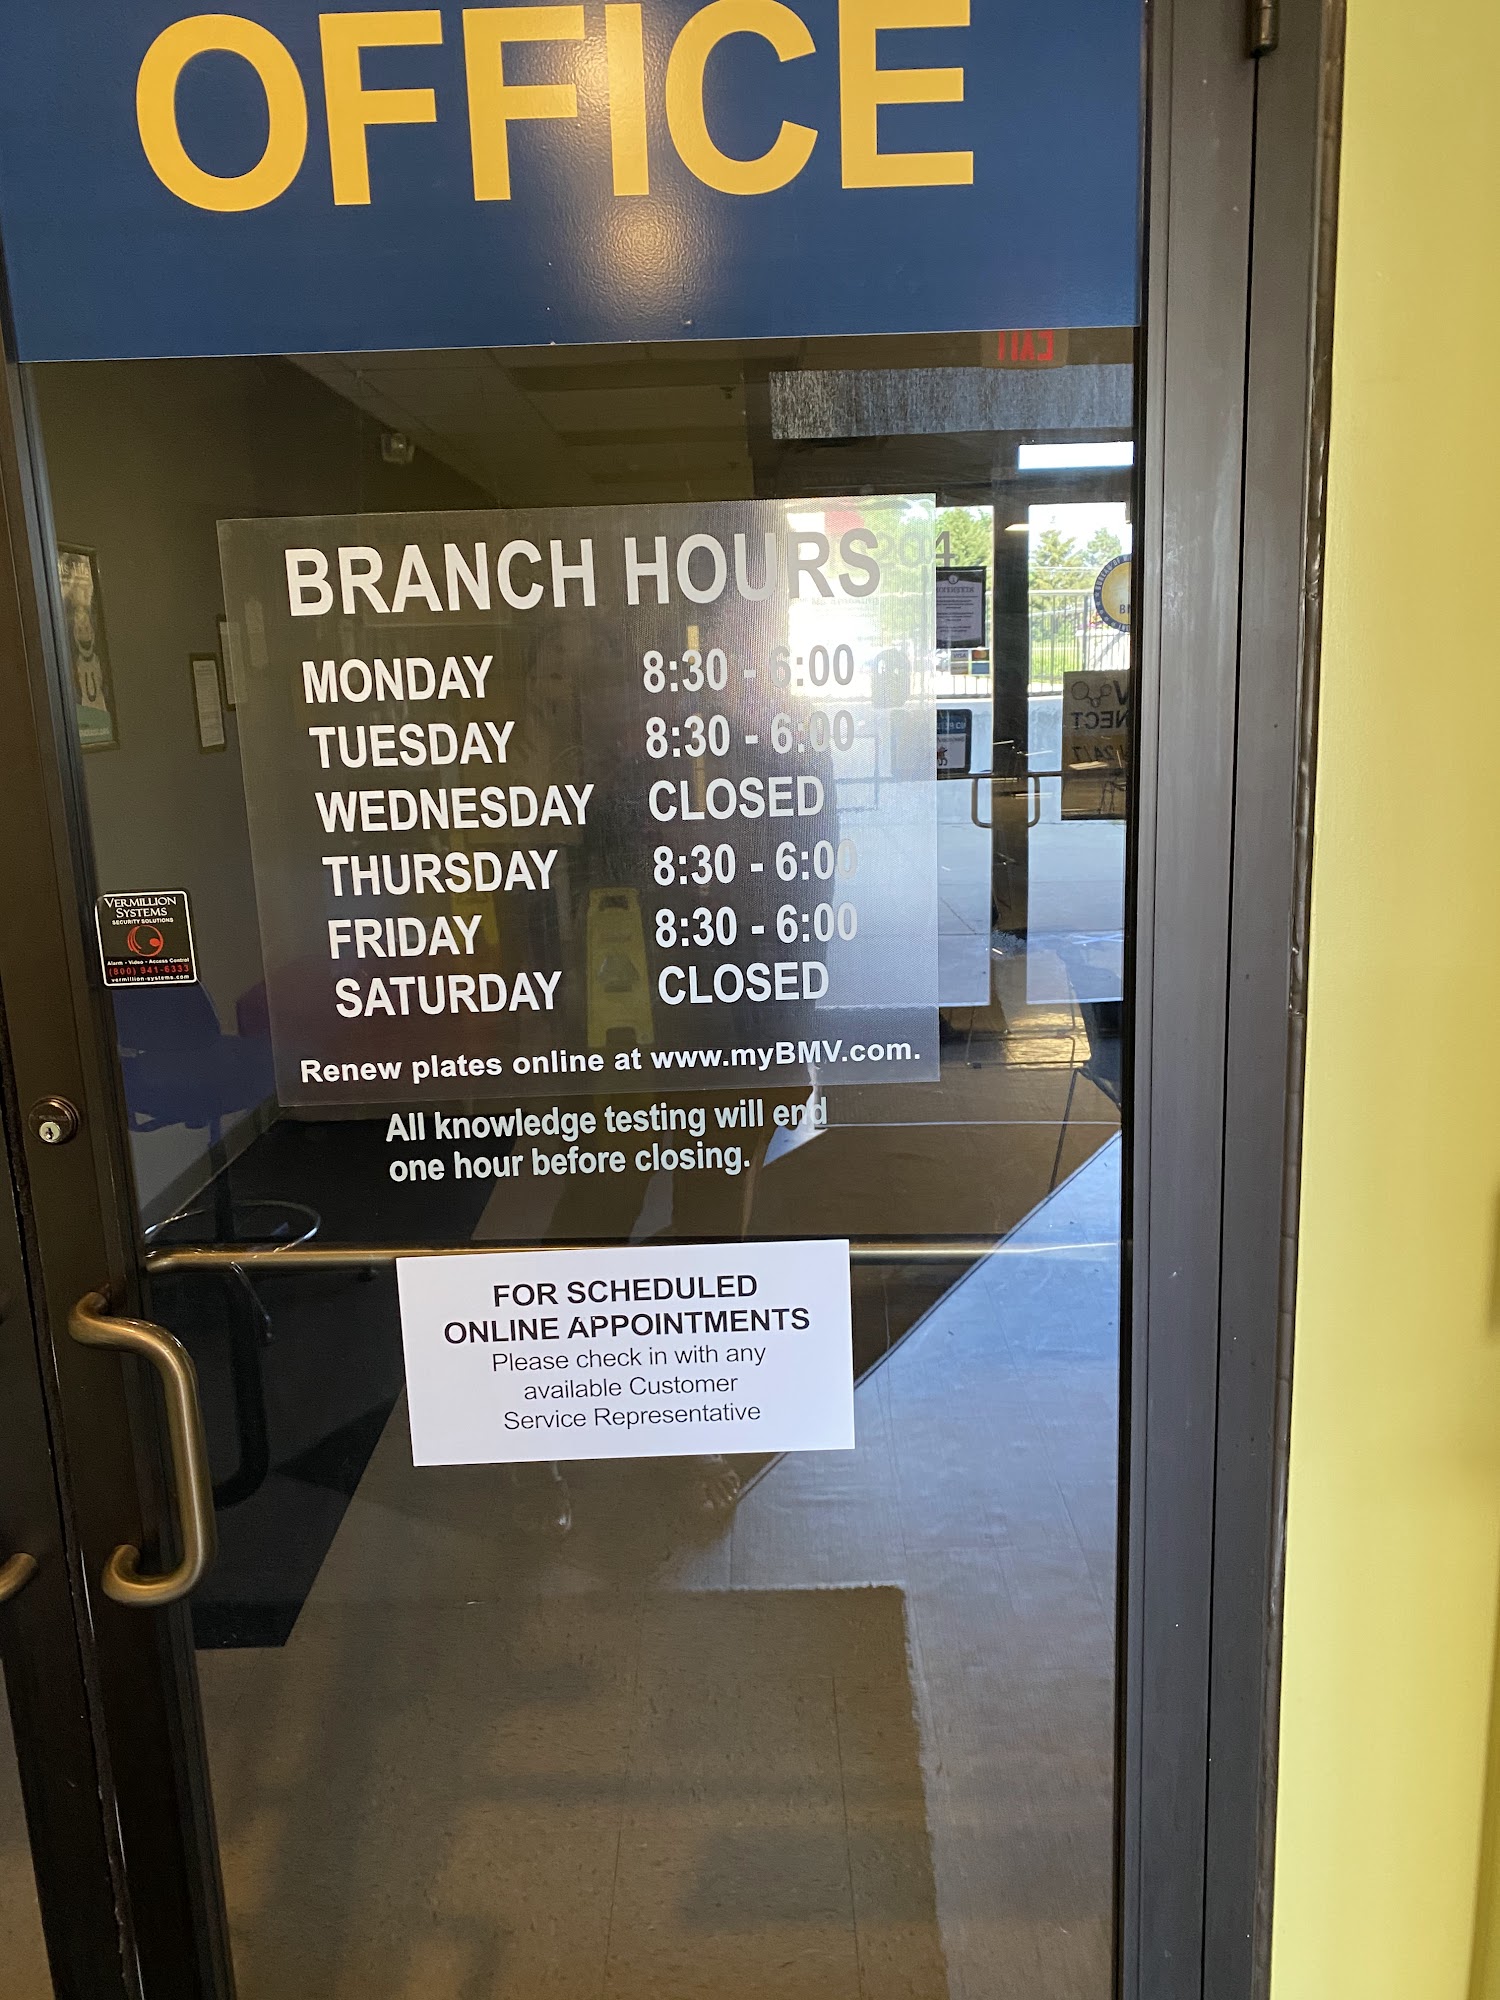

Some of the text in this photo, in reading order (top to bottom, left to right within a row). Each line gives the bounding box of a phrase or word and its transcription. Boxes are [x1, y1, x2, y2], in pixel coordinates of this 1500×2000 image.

[135, 0, 974, 212] OFFICE
[285, 528, 881, 616] BRANCH HOURS
[303, 656, 493, 703] MONDAY
[644, 647, 729, 693] 8:30
[769, 644, 856, 688] 6:00
[309, 721, 515, 768] TUESDAY
[646, 715, 730, 758] 8:30
[770, 710, 856, 754] 6:00
[315, 775, 825, 832] WEDNESDAY CLOSED
[322, 850, 558, 896] THURSDAY
[654, 844, 735, 885] 8:30
[775, 839, 858, 881] 6:00
[104, 897, 176, 908] VERMILLION
[116, 907, 168, 918] SYSTEMS
[328, 915, 482, 959] FRIDAY
[656, 907, 736, 947] 8:30
[776, 902, 858, 943] 6:00
[109, 965, 189, 977] (800) 941-6333
[336, 960, 829, 1017] SATURDAY CLOSED
[301, 1040, 920, 1084] Renew plates online at www.myBMV.com.
[386, 1099, 828, 1142] All knowledge testing will end
[390, 1141, 750, 1182] one hour before closing.
[494, 1275, 757, 1307] FOR SCHEDULED
[445, 1308, 809, 1344] ONLINE APPOINTMENTS
[493, 1345, 765, 1371] Please check in with any
[525, 1377, 738, 1399] available Customer
[505, 1404, 760, 1429] Service Representative
